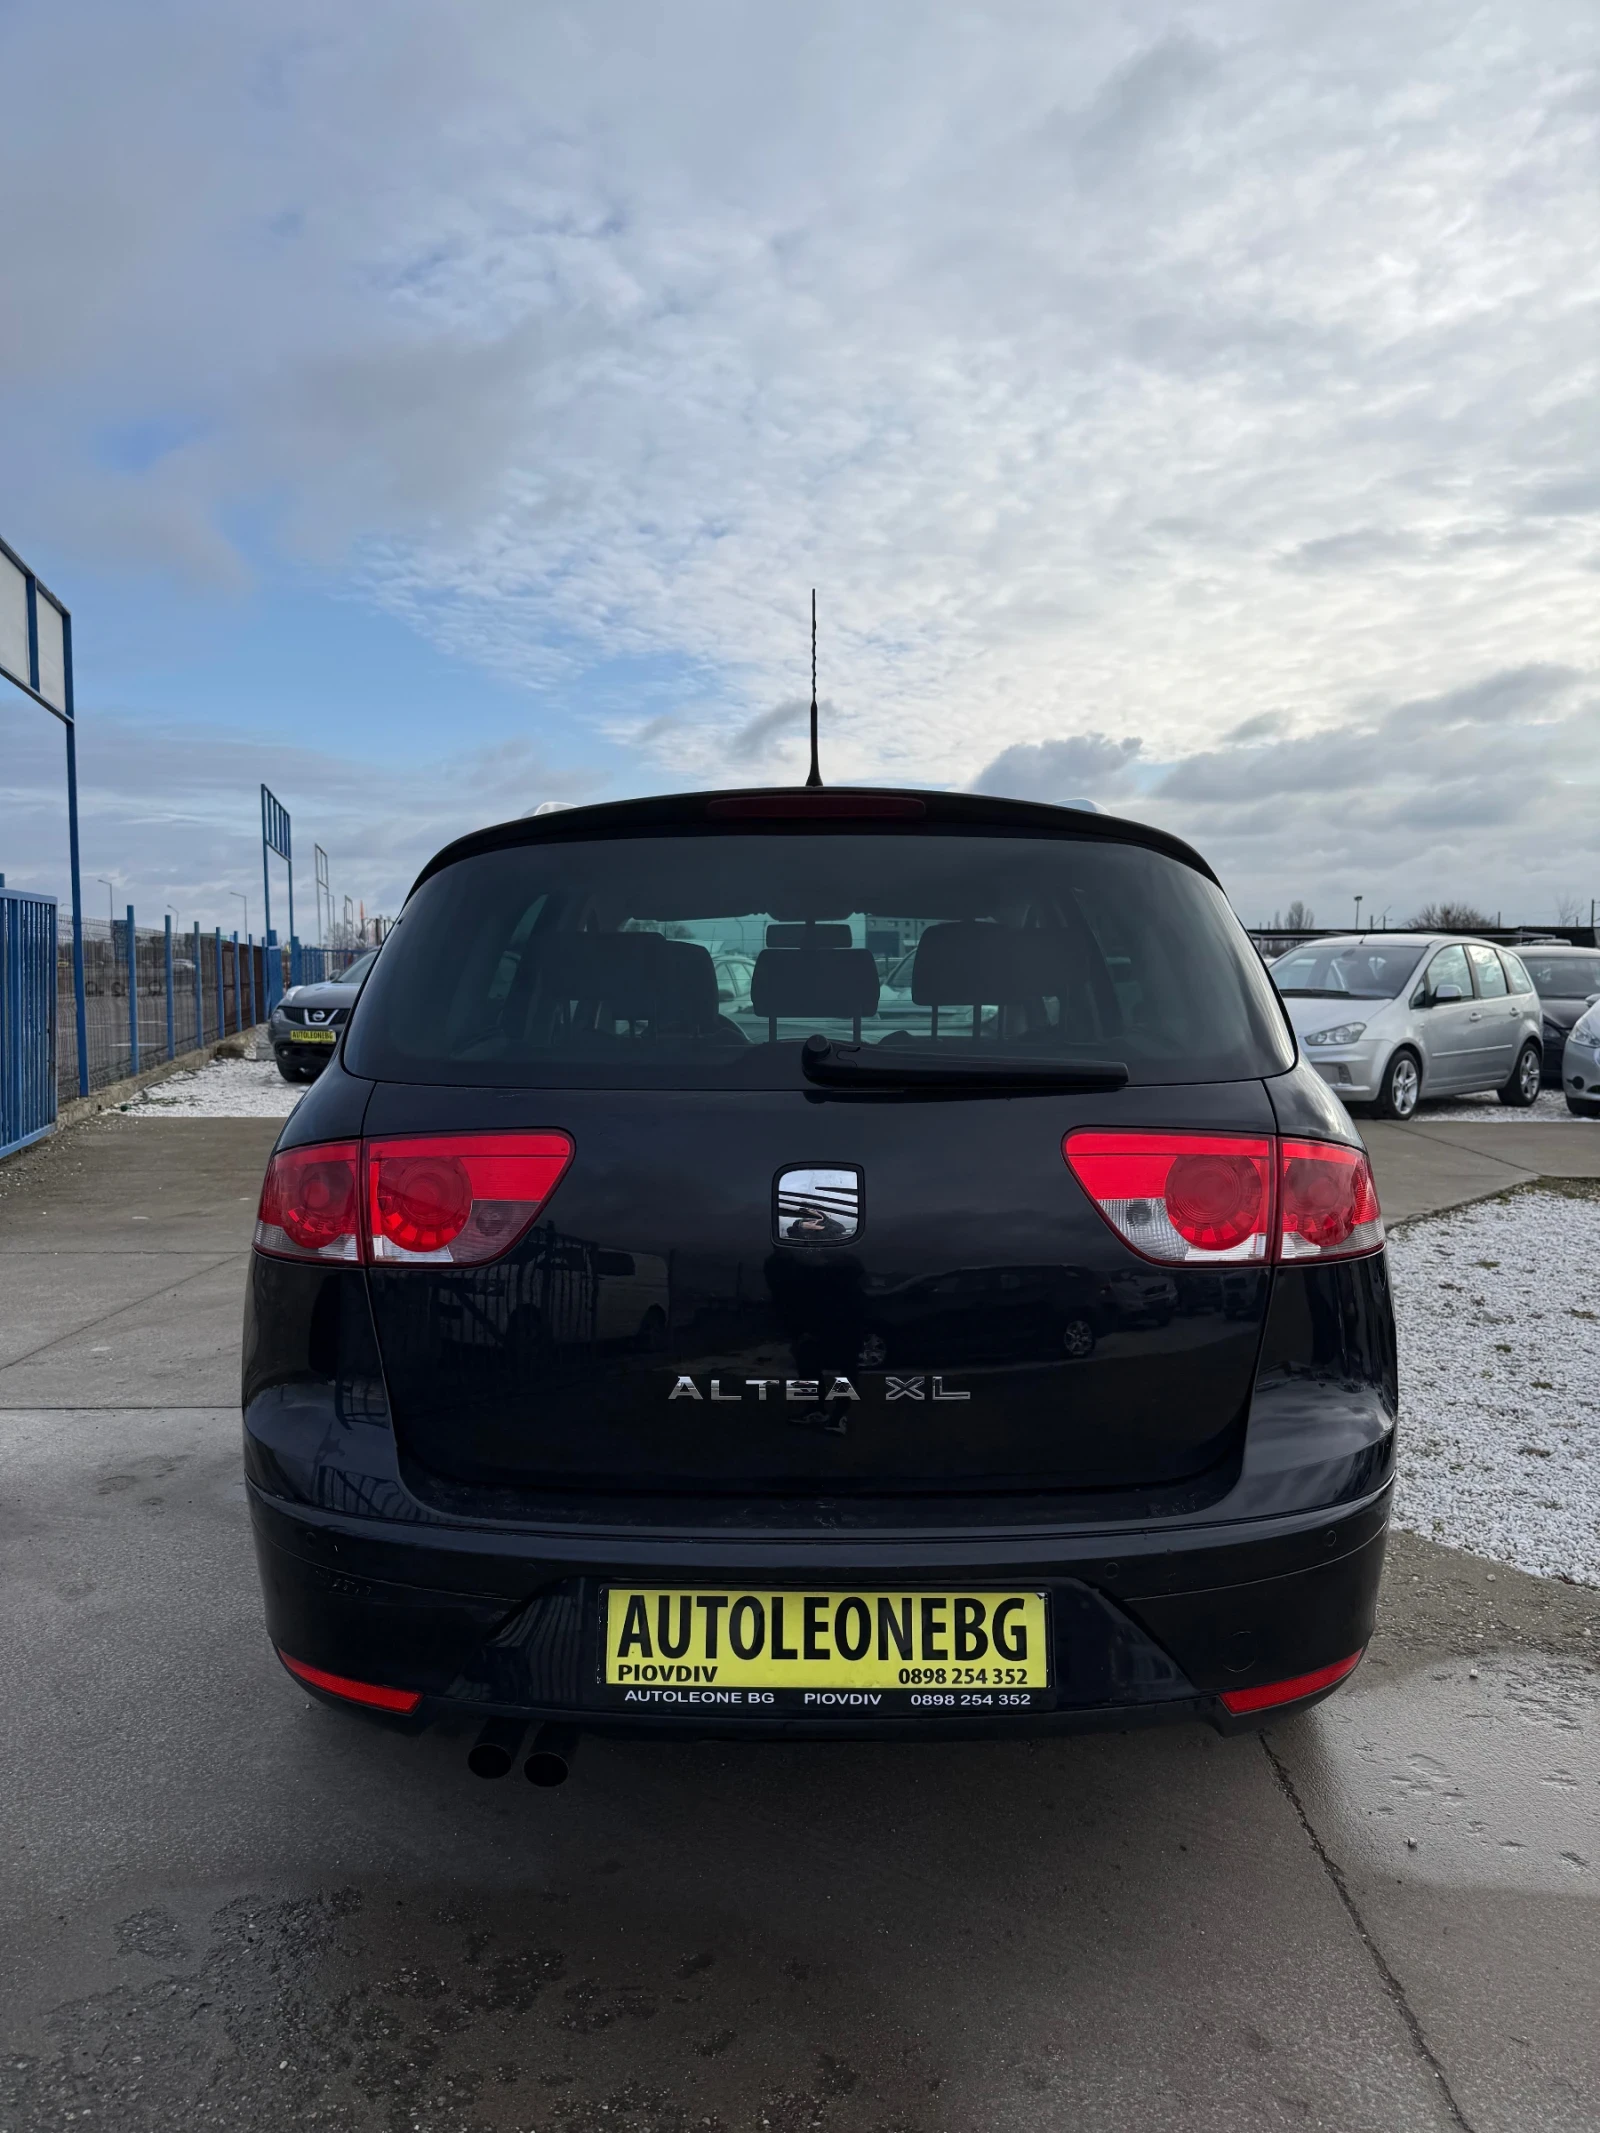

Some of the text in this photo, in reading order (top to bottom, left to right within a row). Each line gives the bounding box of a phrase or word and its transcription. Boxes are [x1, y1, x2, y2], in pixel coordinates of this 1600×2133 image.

[668, 1376, 971, 1400] ALTEA XL
[616, 1594, 1028, 1662] AUTOLEONEBG
[618, 1664, 718, 1683] PIOVDIV
[898, 1667, 1028, 1685] 0898 254 352
[624, 1689, 1031, 1706] AUTOLEONE BG PIOVDIV 0898 254 352
